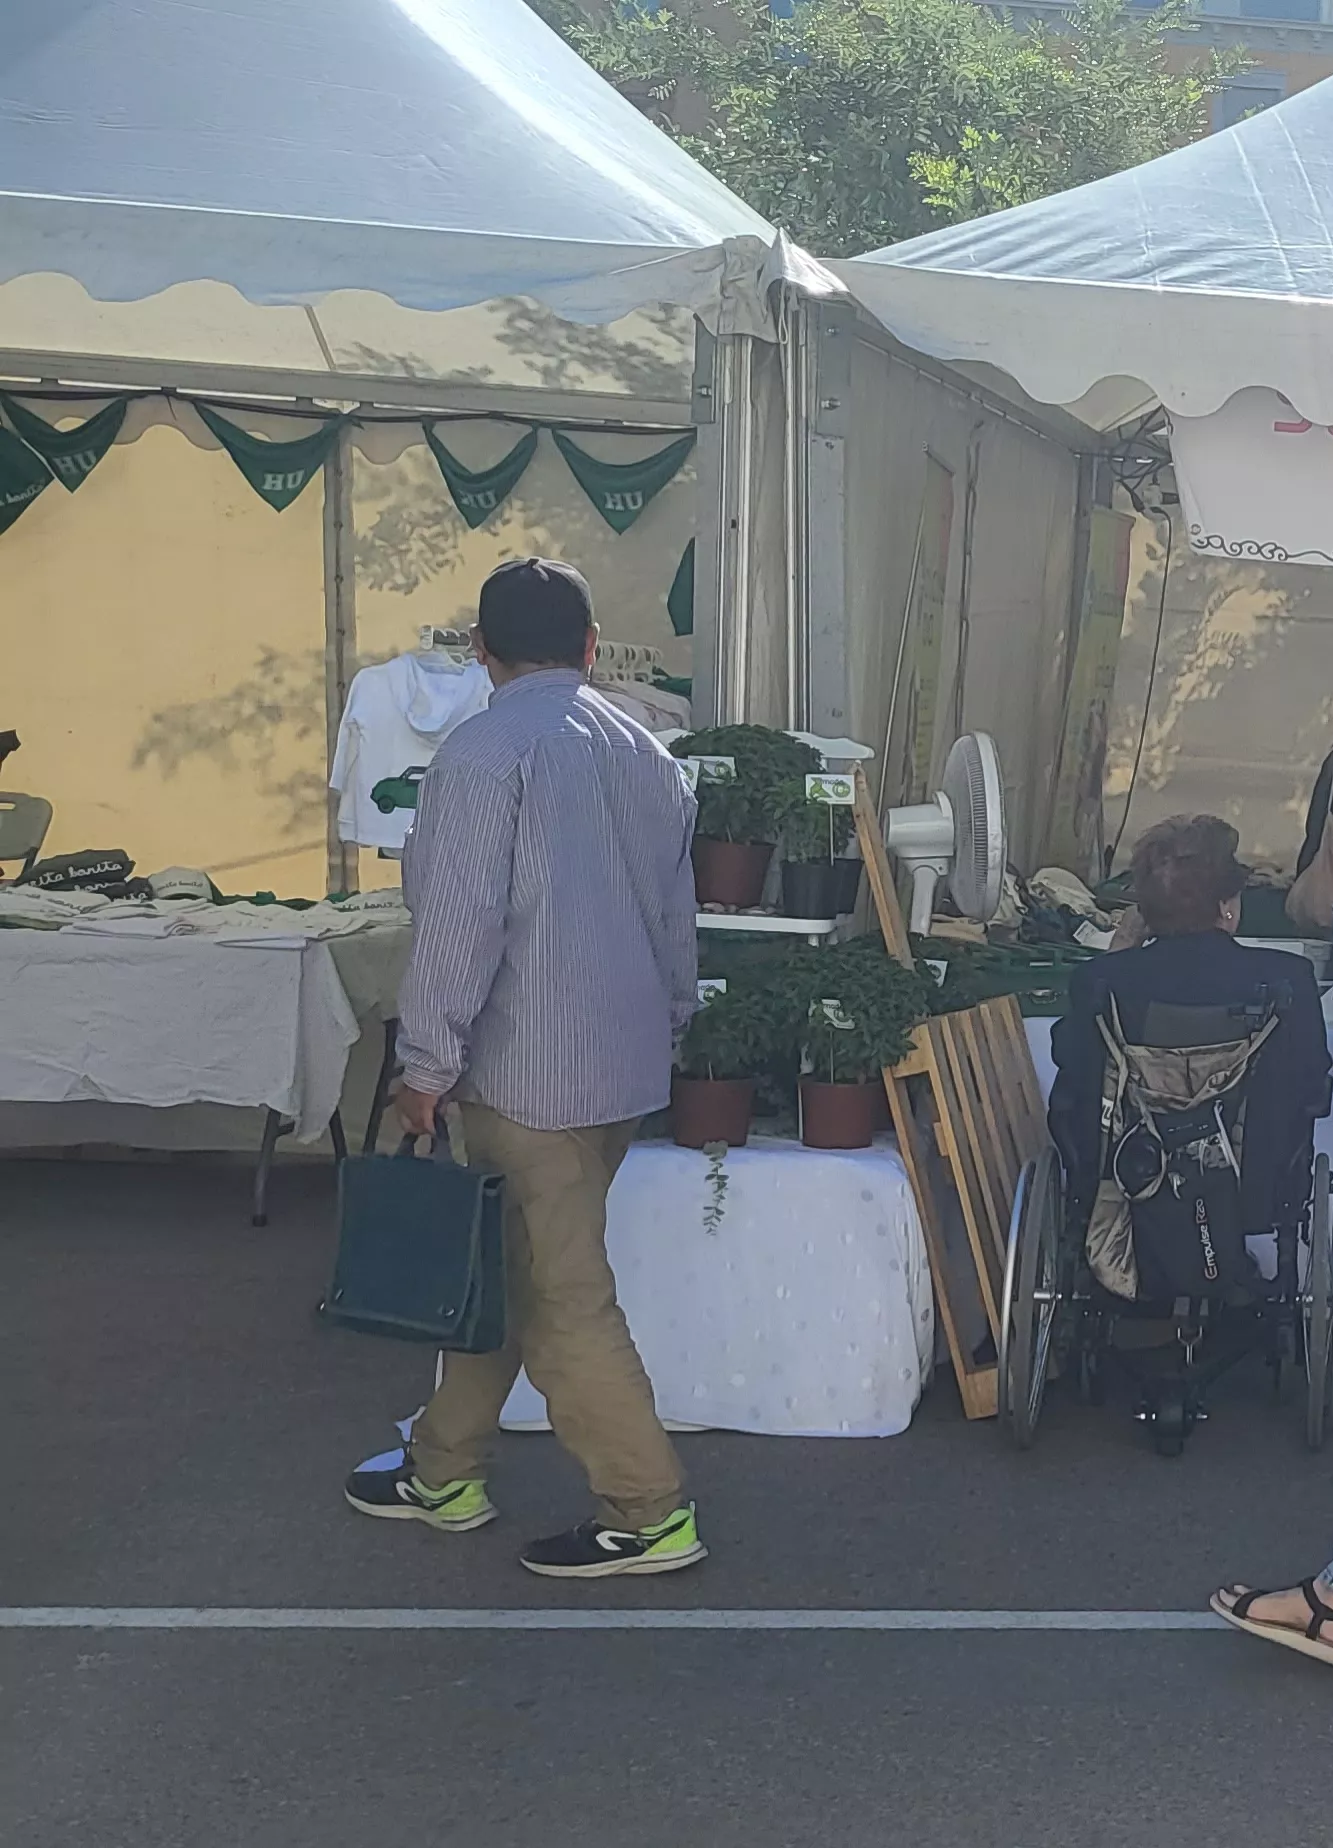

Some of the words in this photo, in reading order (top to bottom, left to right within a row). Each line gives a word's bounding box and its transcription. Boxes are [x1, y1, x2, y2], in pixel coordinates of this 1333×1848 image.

[54, 450, 98, 476] HU
[262, 470, 305, 491] HU
[459, 489, 497, 509] HU
[604, 492, 644, 511] HU
[68, 860, 123, 878] bonita
[1200, 1223, 1219, 1280] Empulse
